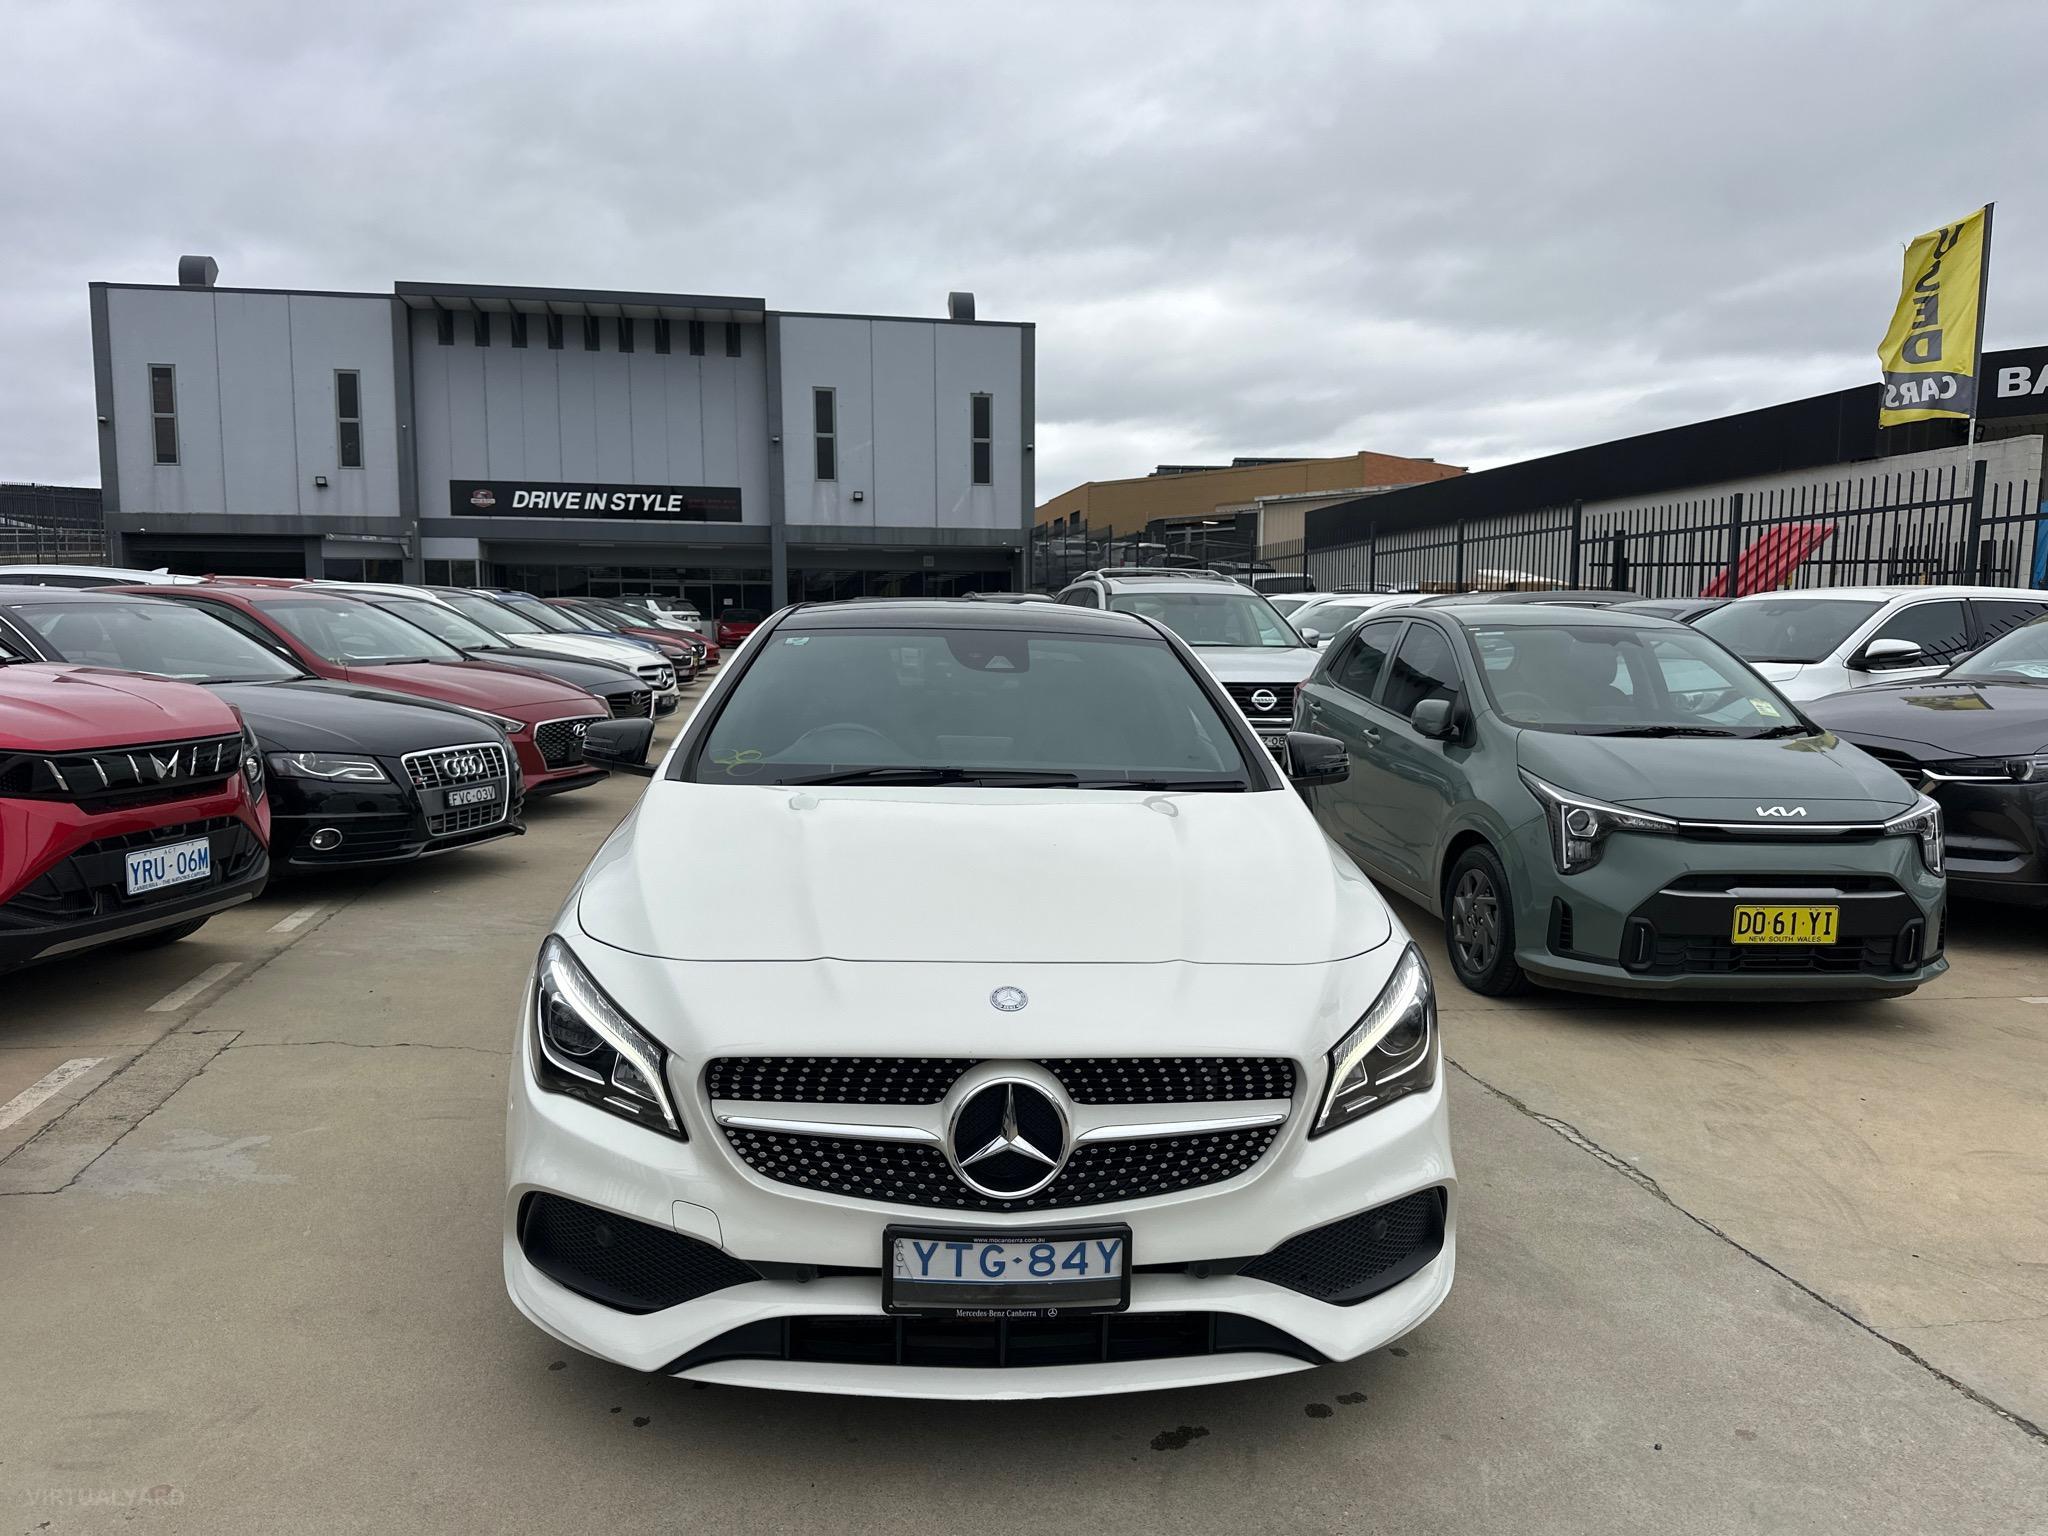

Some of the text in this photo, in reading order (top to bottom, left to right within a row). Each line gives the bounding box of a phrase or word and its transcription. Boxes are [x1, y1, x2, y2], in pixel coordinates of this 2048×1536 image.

[512, 490, 581, 510] DRIVE
[584, 493, 607, 510] IN
[611, 493, 683, 512] STYLE
[1755, 806, 1807, 817] KIA
[1768, 935, 1794, 943] SOUTH
[1797, 935, 1822, 943] WALES
[956, 1308, 1037, 1317] Mercedes-Benz Canberra
